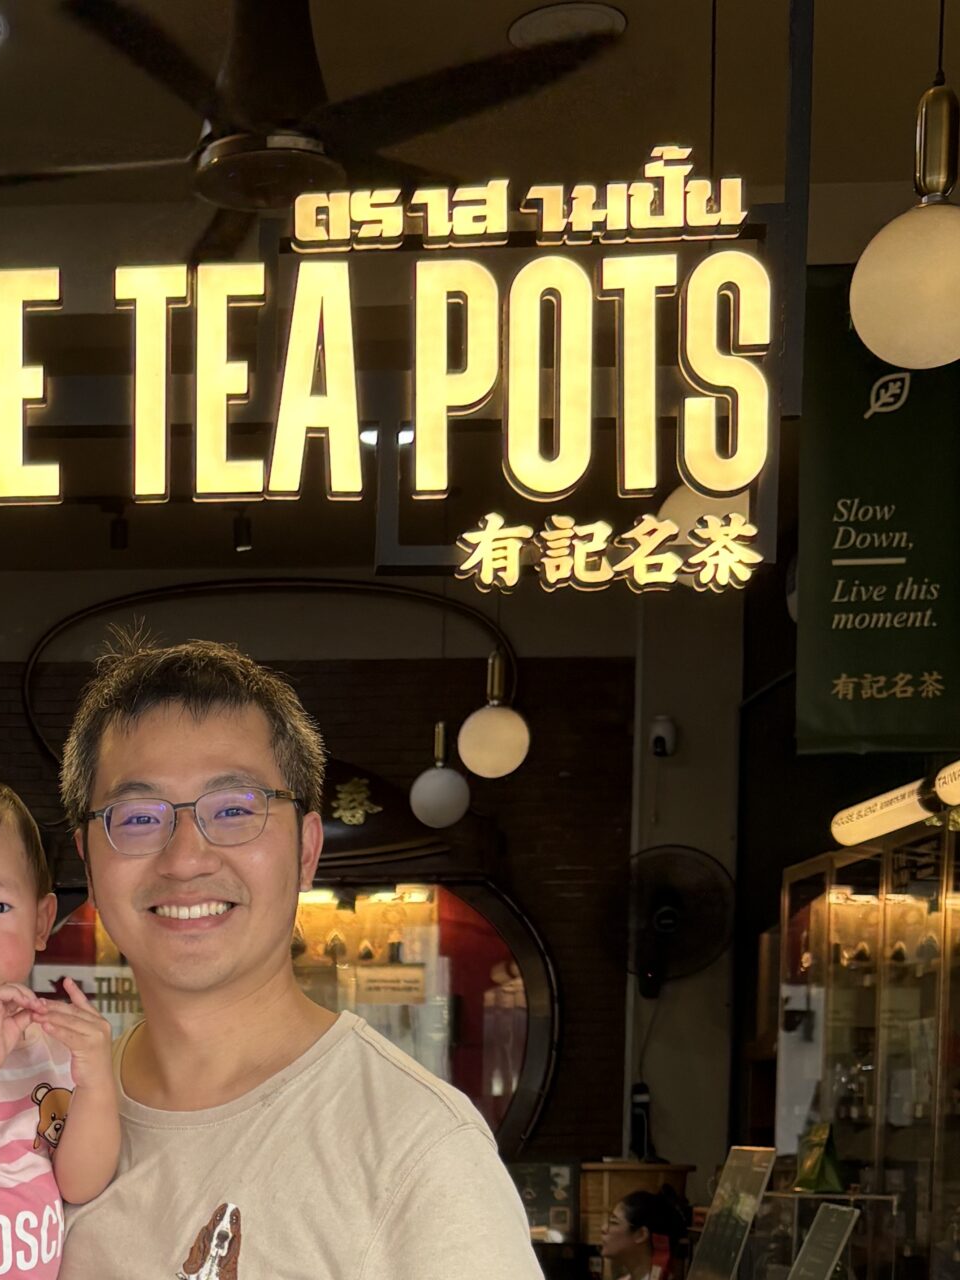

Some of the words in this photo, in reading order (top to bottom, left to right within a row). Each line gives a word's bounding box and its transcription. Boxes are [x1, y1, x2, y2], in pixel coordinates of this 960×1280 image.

[115, 261, 364, 502] TEA
[413, 251, 771, 501] POTS
[832, 498, 895, 522] Slow
[832, 526, 914, 550] Down,
[456, 513, 763, 592] 有記名茶
[832, 579, 887, 602] Live
[895, 577, 940, 600] this
[831, 608, 938, 630] moment.
[831, 672, 945, 700] 有記名茶
